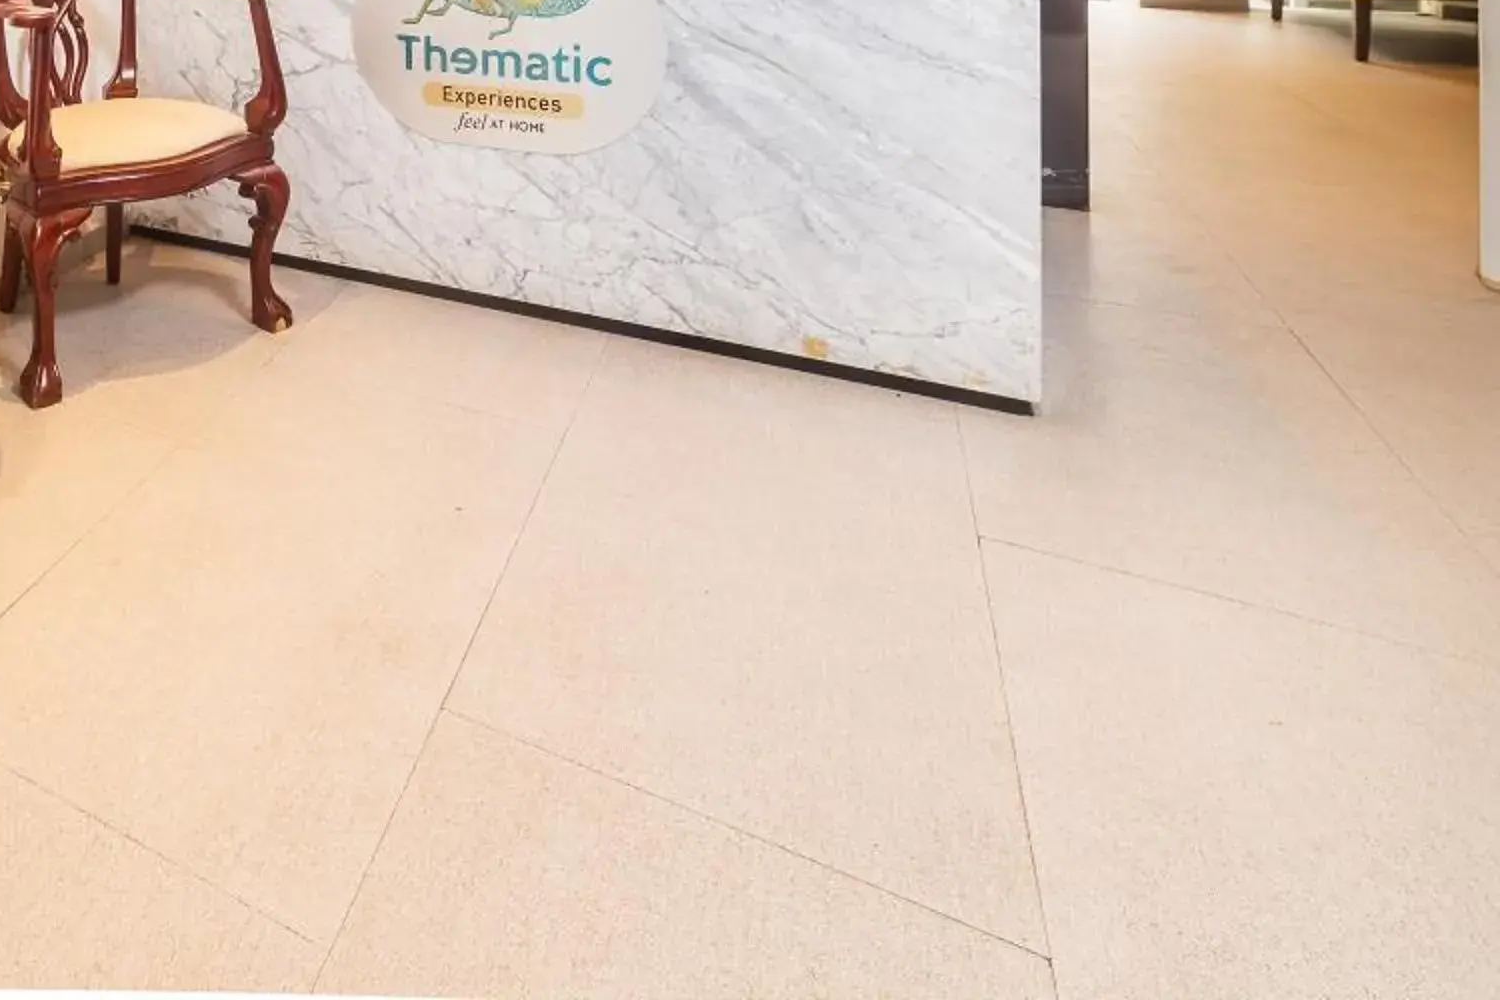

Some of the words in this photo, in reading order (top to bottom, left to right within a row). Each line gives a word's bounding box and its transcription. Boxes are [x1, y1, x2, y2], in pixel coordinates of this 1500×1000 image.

[442, 85, 563, 114] Experiences
[453, 112, 489, 133] feel
[489, 119, 504, 130] AT
[509, 120, 545, 134] HOME
